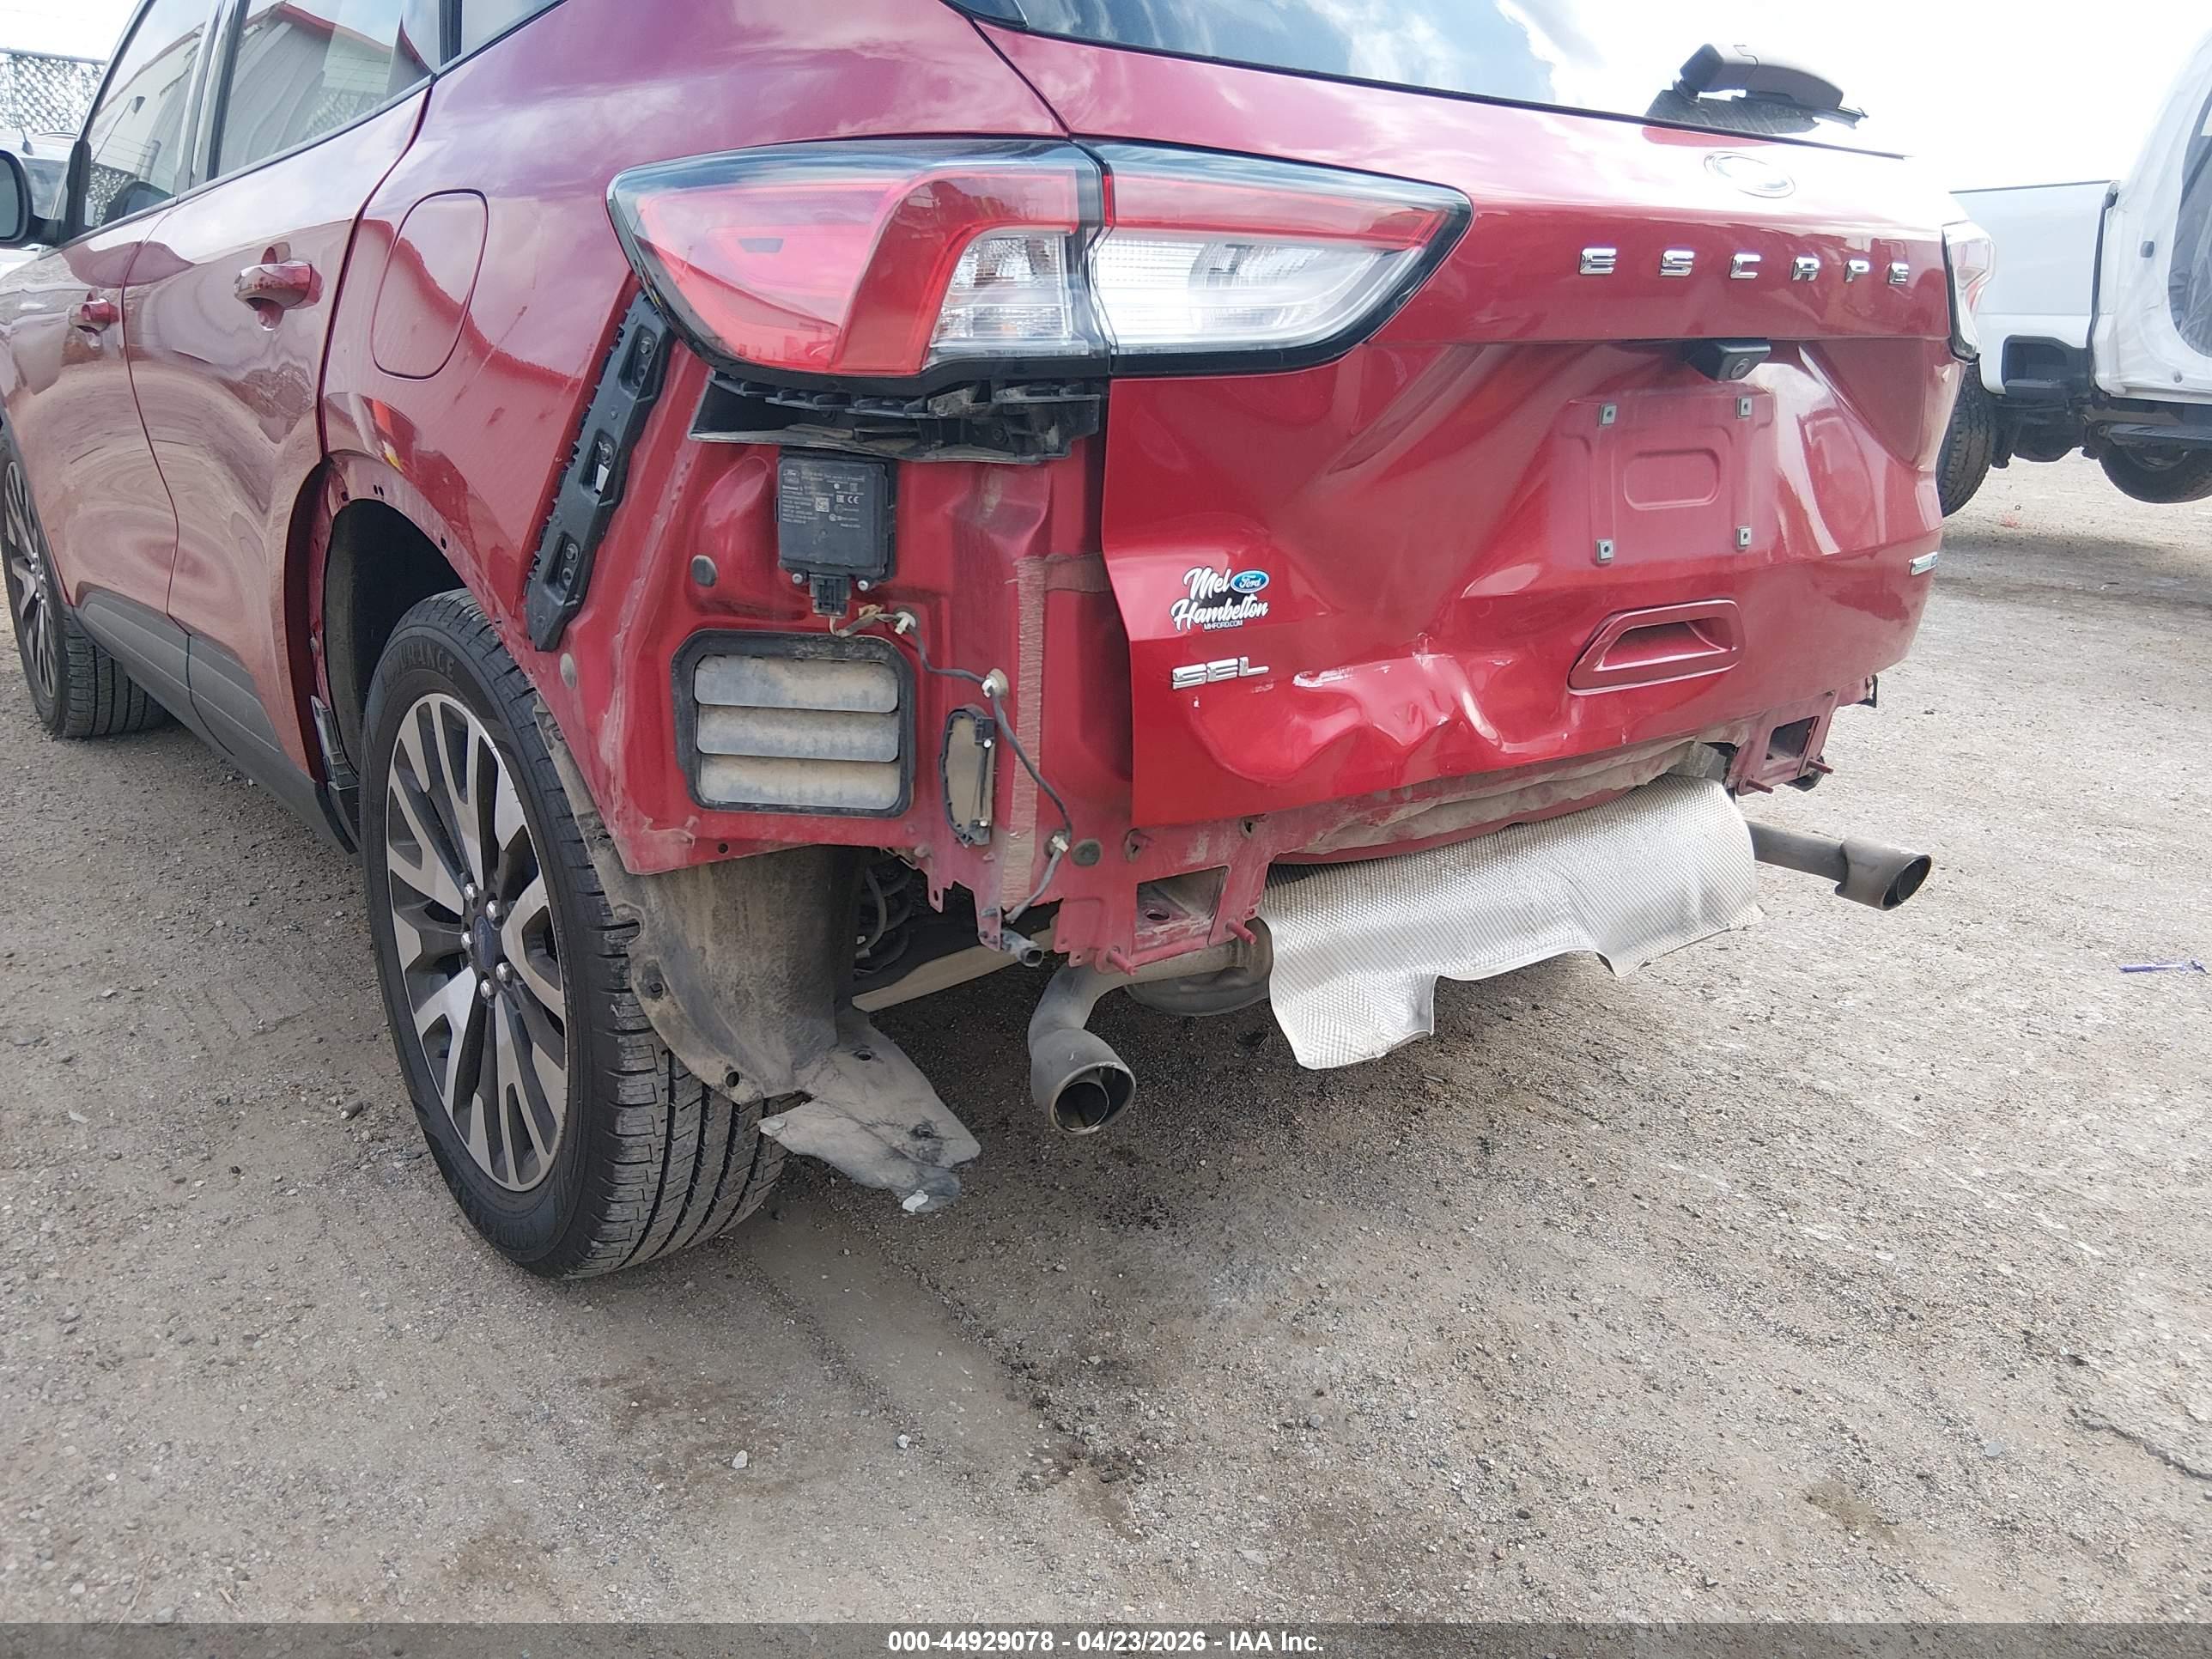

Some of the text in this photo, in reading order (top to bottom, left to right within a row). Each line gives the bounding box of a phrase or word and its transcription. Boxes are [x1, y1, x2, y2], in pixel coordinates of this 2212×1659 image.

[1579, 247, 1909, 284] ESCAPE
[1184, 567, 1231, 600] Mel
[1239, 574, 1262, 588] Ford
[1170, 593, 1269, 631] Hambelton
[1172, 656, 1270, 690] SEL
